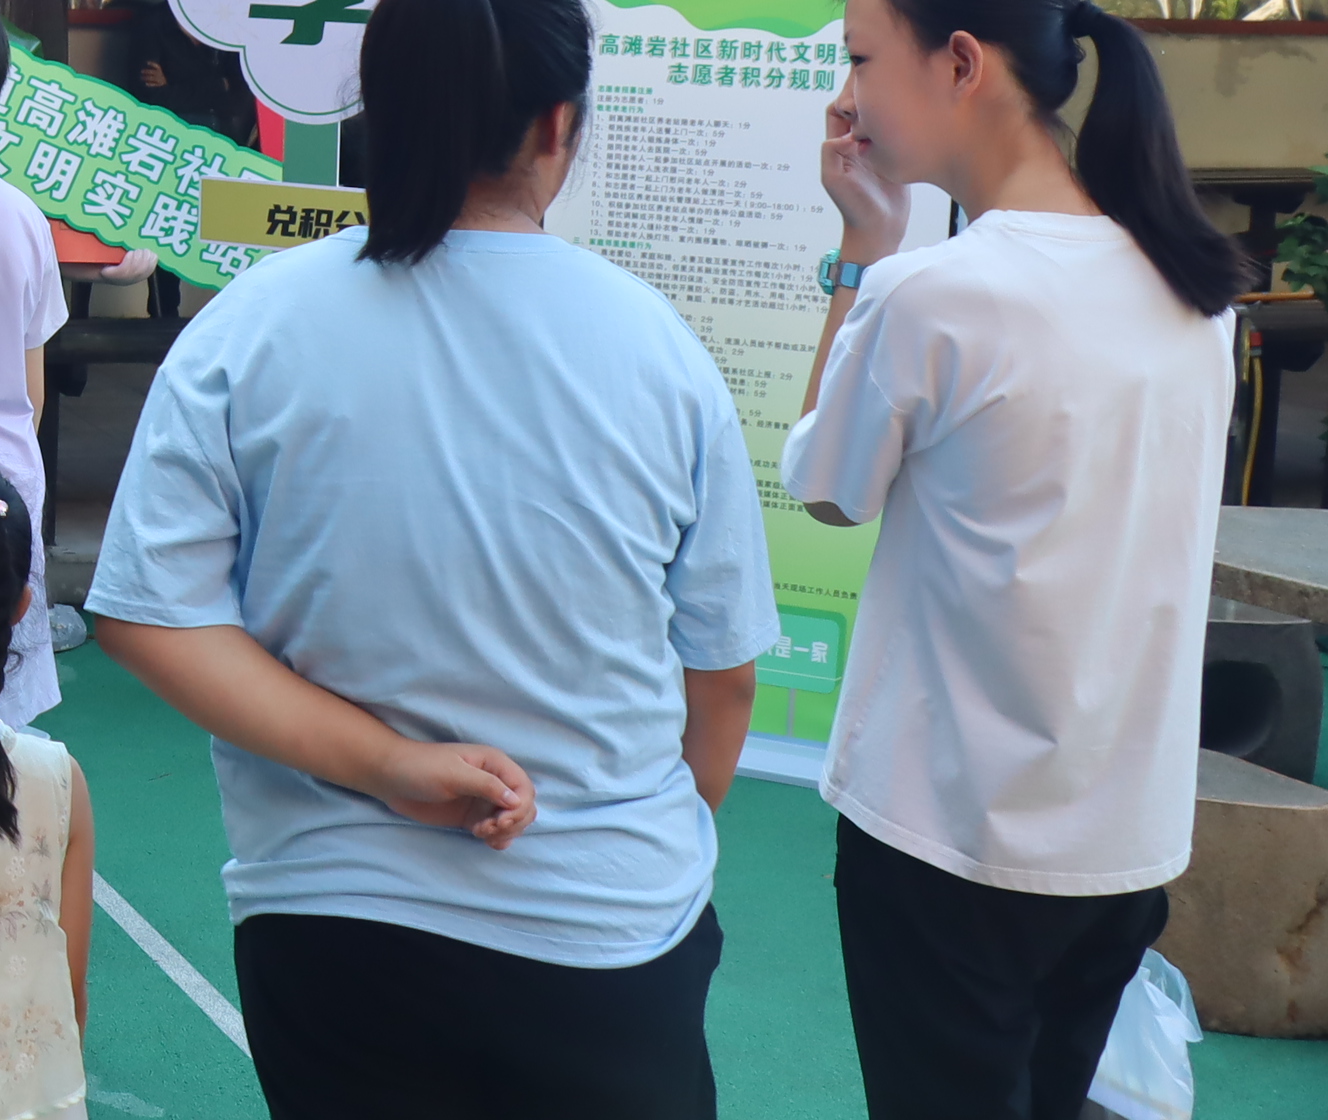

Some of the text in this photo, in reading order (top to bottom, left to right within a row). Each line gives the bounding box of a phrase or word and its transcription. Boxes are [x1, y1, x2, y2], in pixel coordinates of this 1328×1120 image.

[666, 63, 836, 92] 志愿者积分规则
[767, 635, 829, 664] 是一家
